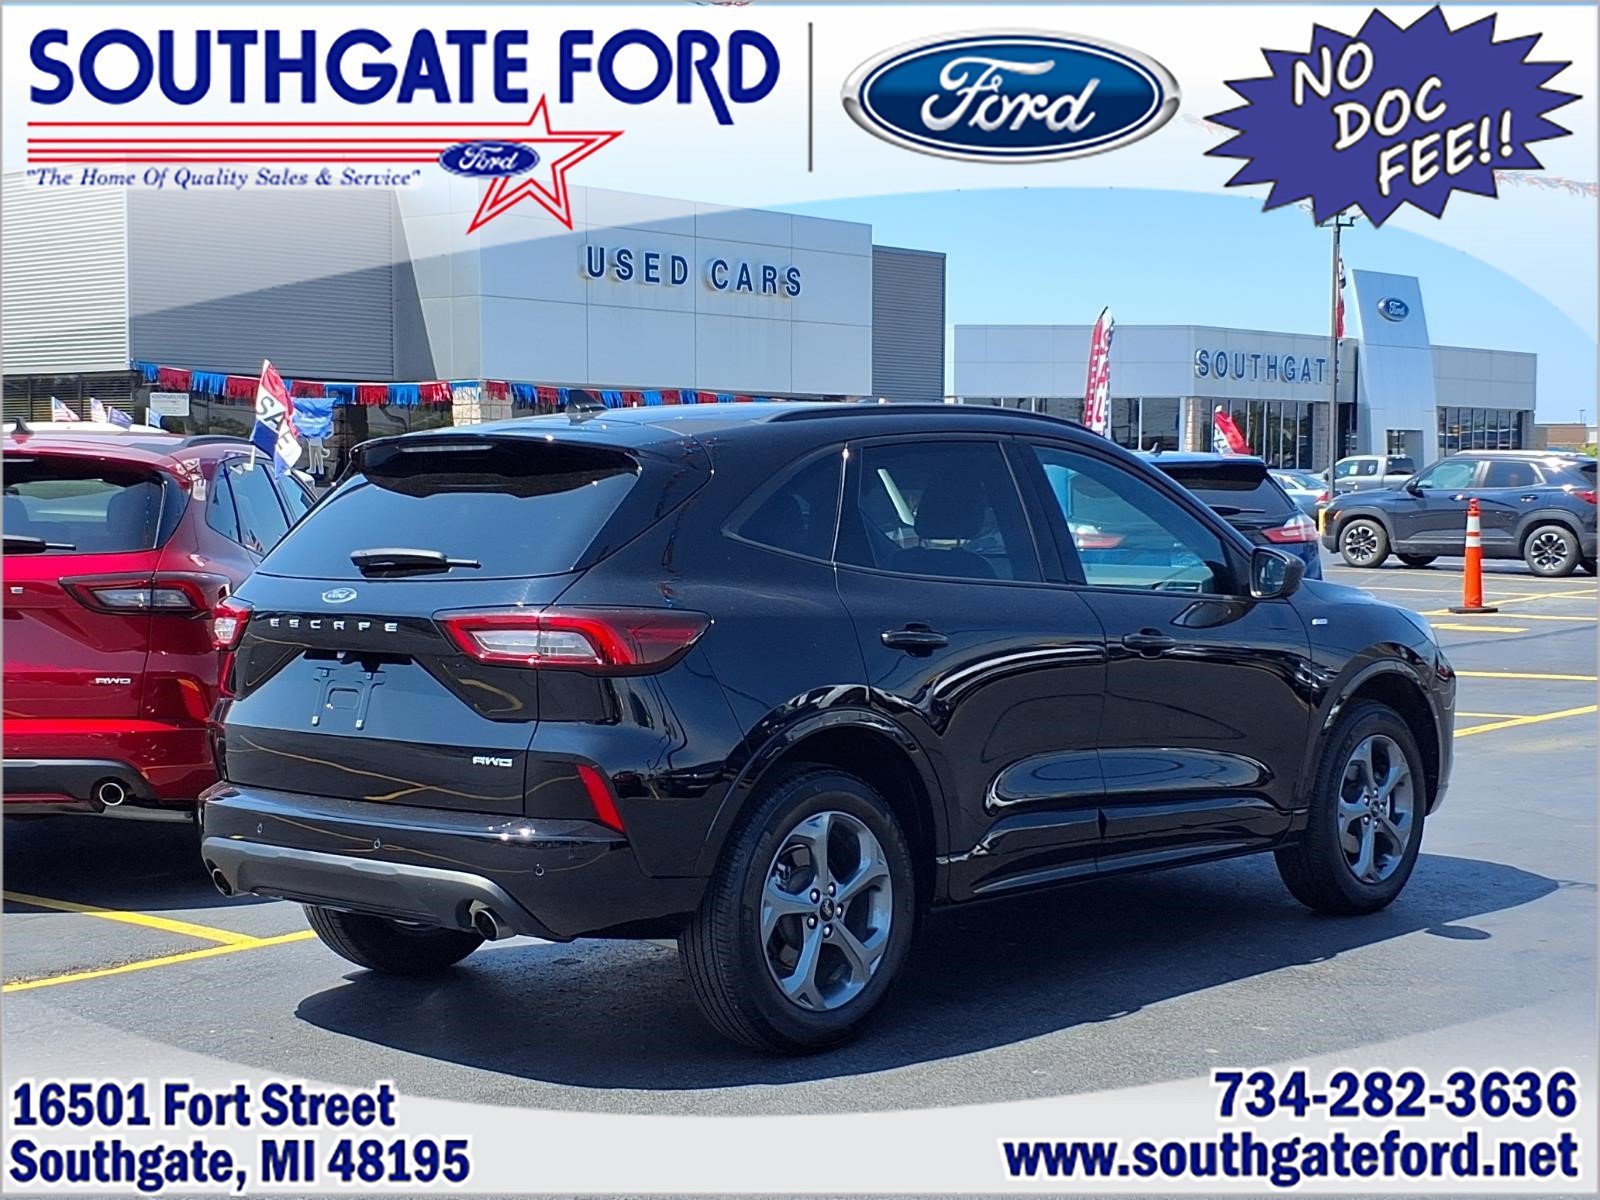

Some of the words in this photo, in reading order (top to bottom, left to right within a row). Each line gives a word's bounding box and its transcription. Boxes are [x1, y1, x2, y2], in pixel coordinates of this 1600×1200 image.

[586, 244, 689, 287] USED
[710, 258, 802, 298] CARS
[269, 617, 398, 633] ESCAPE
[95, 677, 131, 685] AWD
[472, 756, 513, 768] AWD
